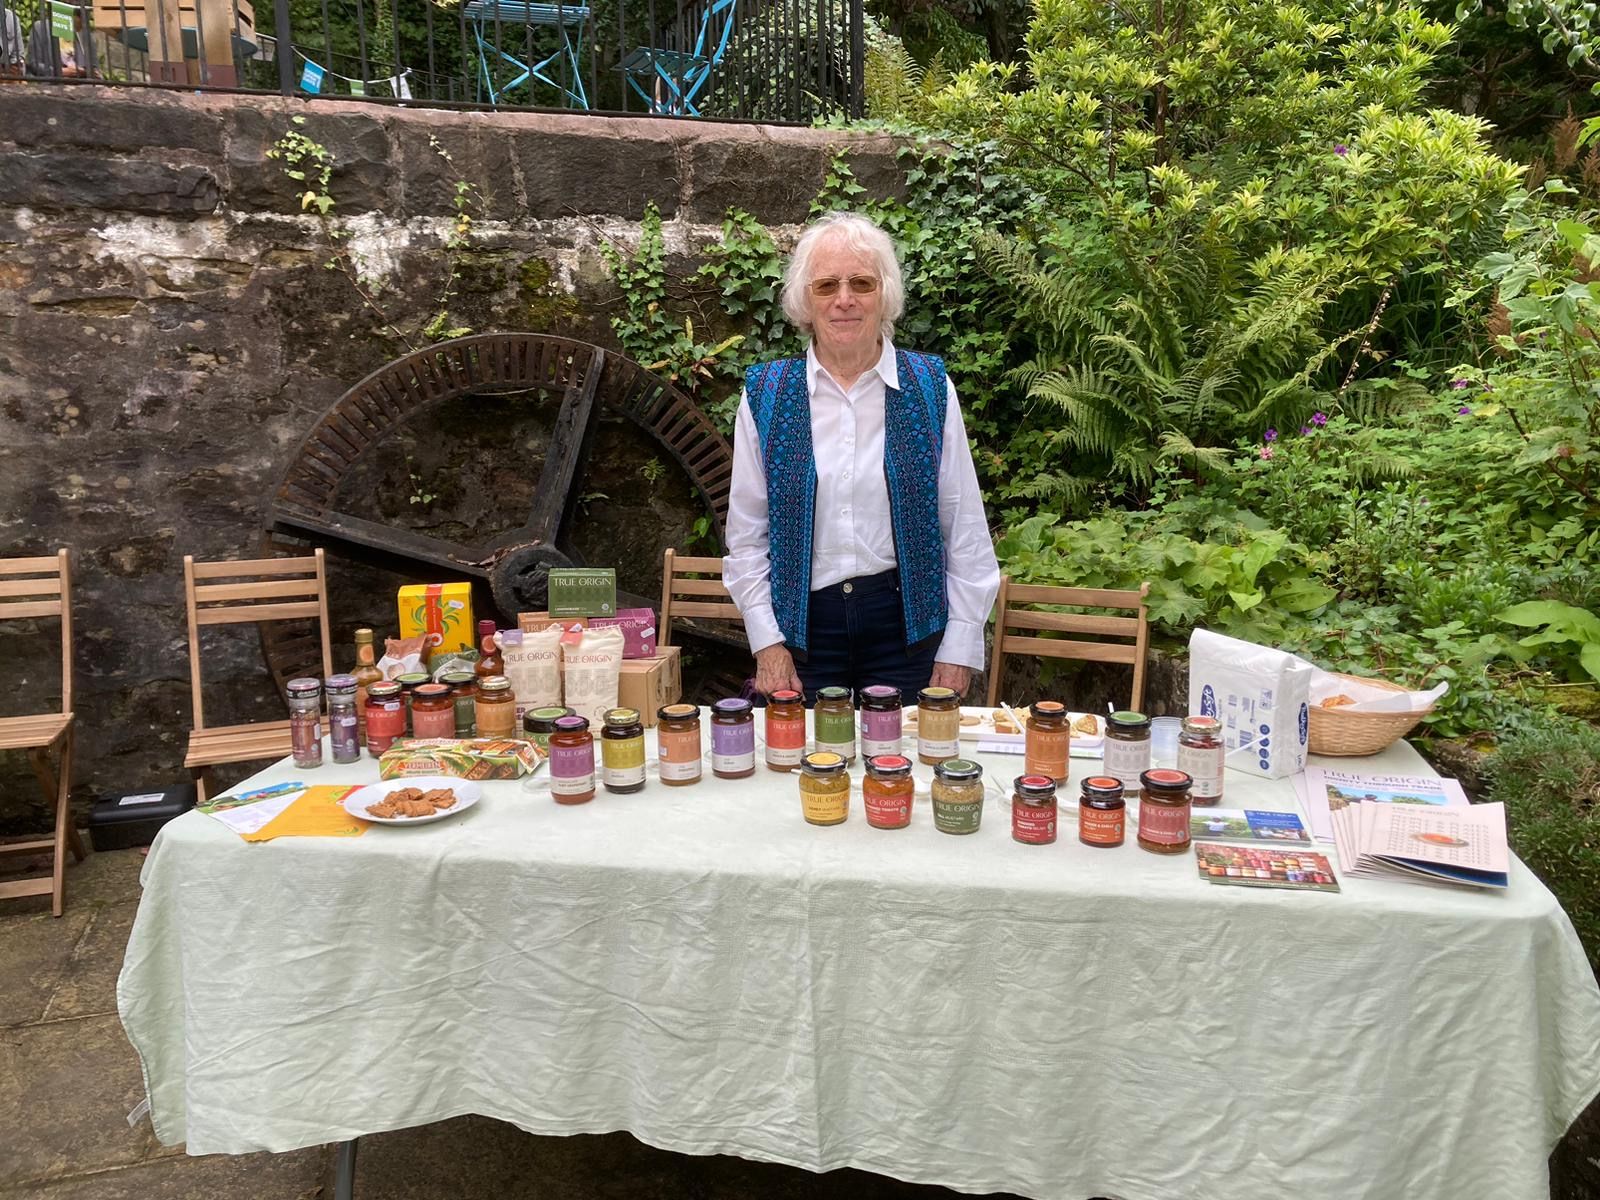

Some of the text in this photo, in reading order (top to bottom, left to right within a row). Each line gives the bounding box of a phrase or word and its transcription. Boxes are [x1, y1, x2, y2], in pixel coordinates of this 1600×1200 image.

[554, 577, 612, 587] TRUE ORIGIN
[527, 651, 560, 662] ORIGIN
[566, 655, 613, 664] RUE ORIGIN
[556, 750, 573, 758] TRUE
[1322, 768, 1442, 787] TRUE ORIGIN
[807, 794, 822, 803] TRUE
[879, 799, 907, 807] ORIGIN
[936, 802, 980, 812] TRUE ORIGIN
[1016, 809, 1053, 819] TRUE ORIGIN
[1084, 810, 1121, 820] TRUE ORIGIN
[1158, 808, 1185, 817] ORIGIN
